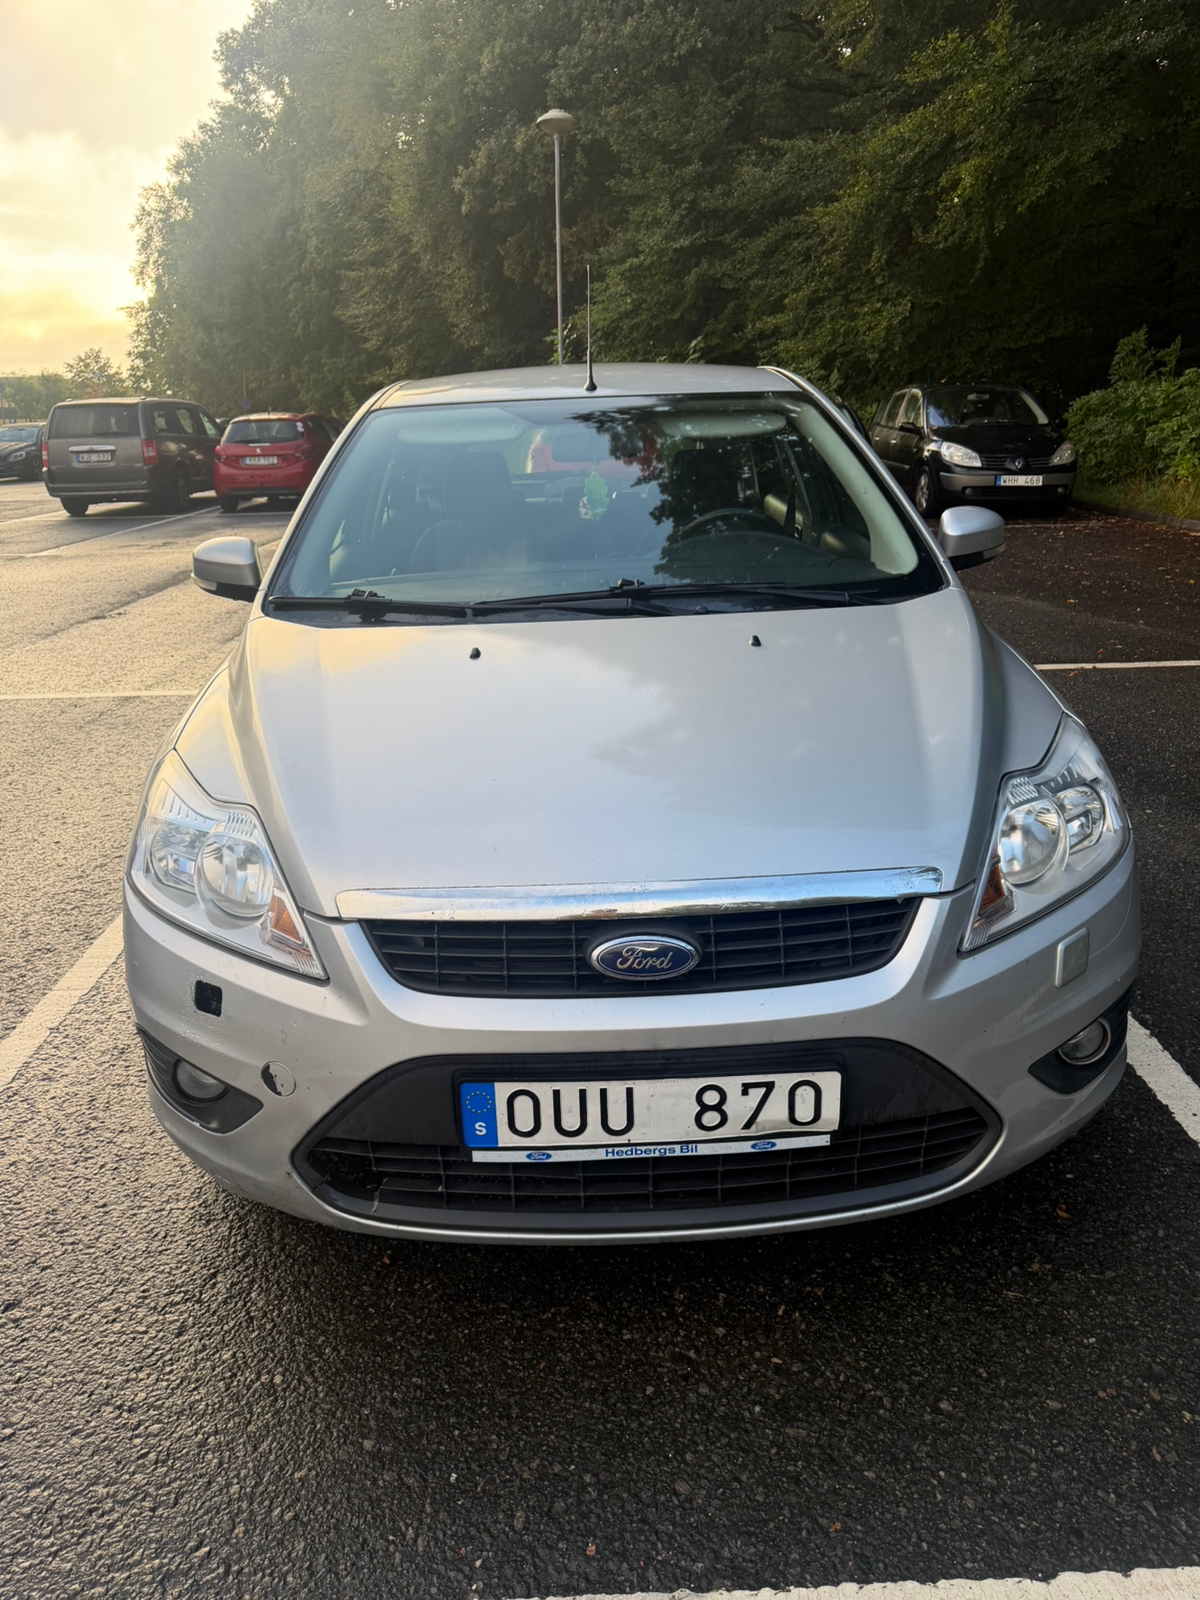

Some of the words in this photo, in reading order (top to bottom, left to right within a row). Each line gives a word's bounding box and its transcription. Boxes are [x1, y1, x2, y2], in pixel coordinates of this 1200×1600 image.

[1002, 476, 1019, 485] WHH
[1024, 476, 1041, 485] 468
[616, 945, 673, 970] Ford
[506, 1087, 635, 1138] OUU
[694, 1079, 823, 1132] 870
[474, 1122, 487, 1136] S
[605, 1146, 676, 1157] Hedbergs
[680, 1144, 698, 1154] Bil
